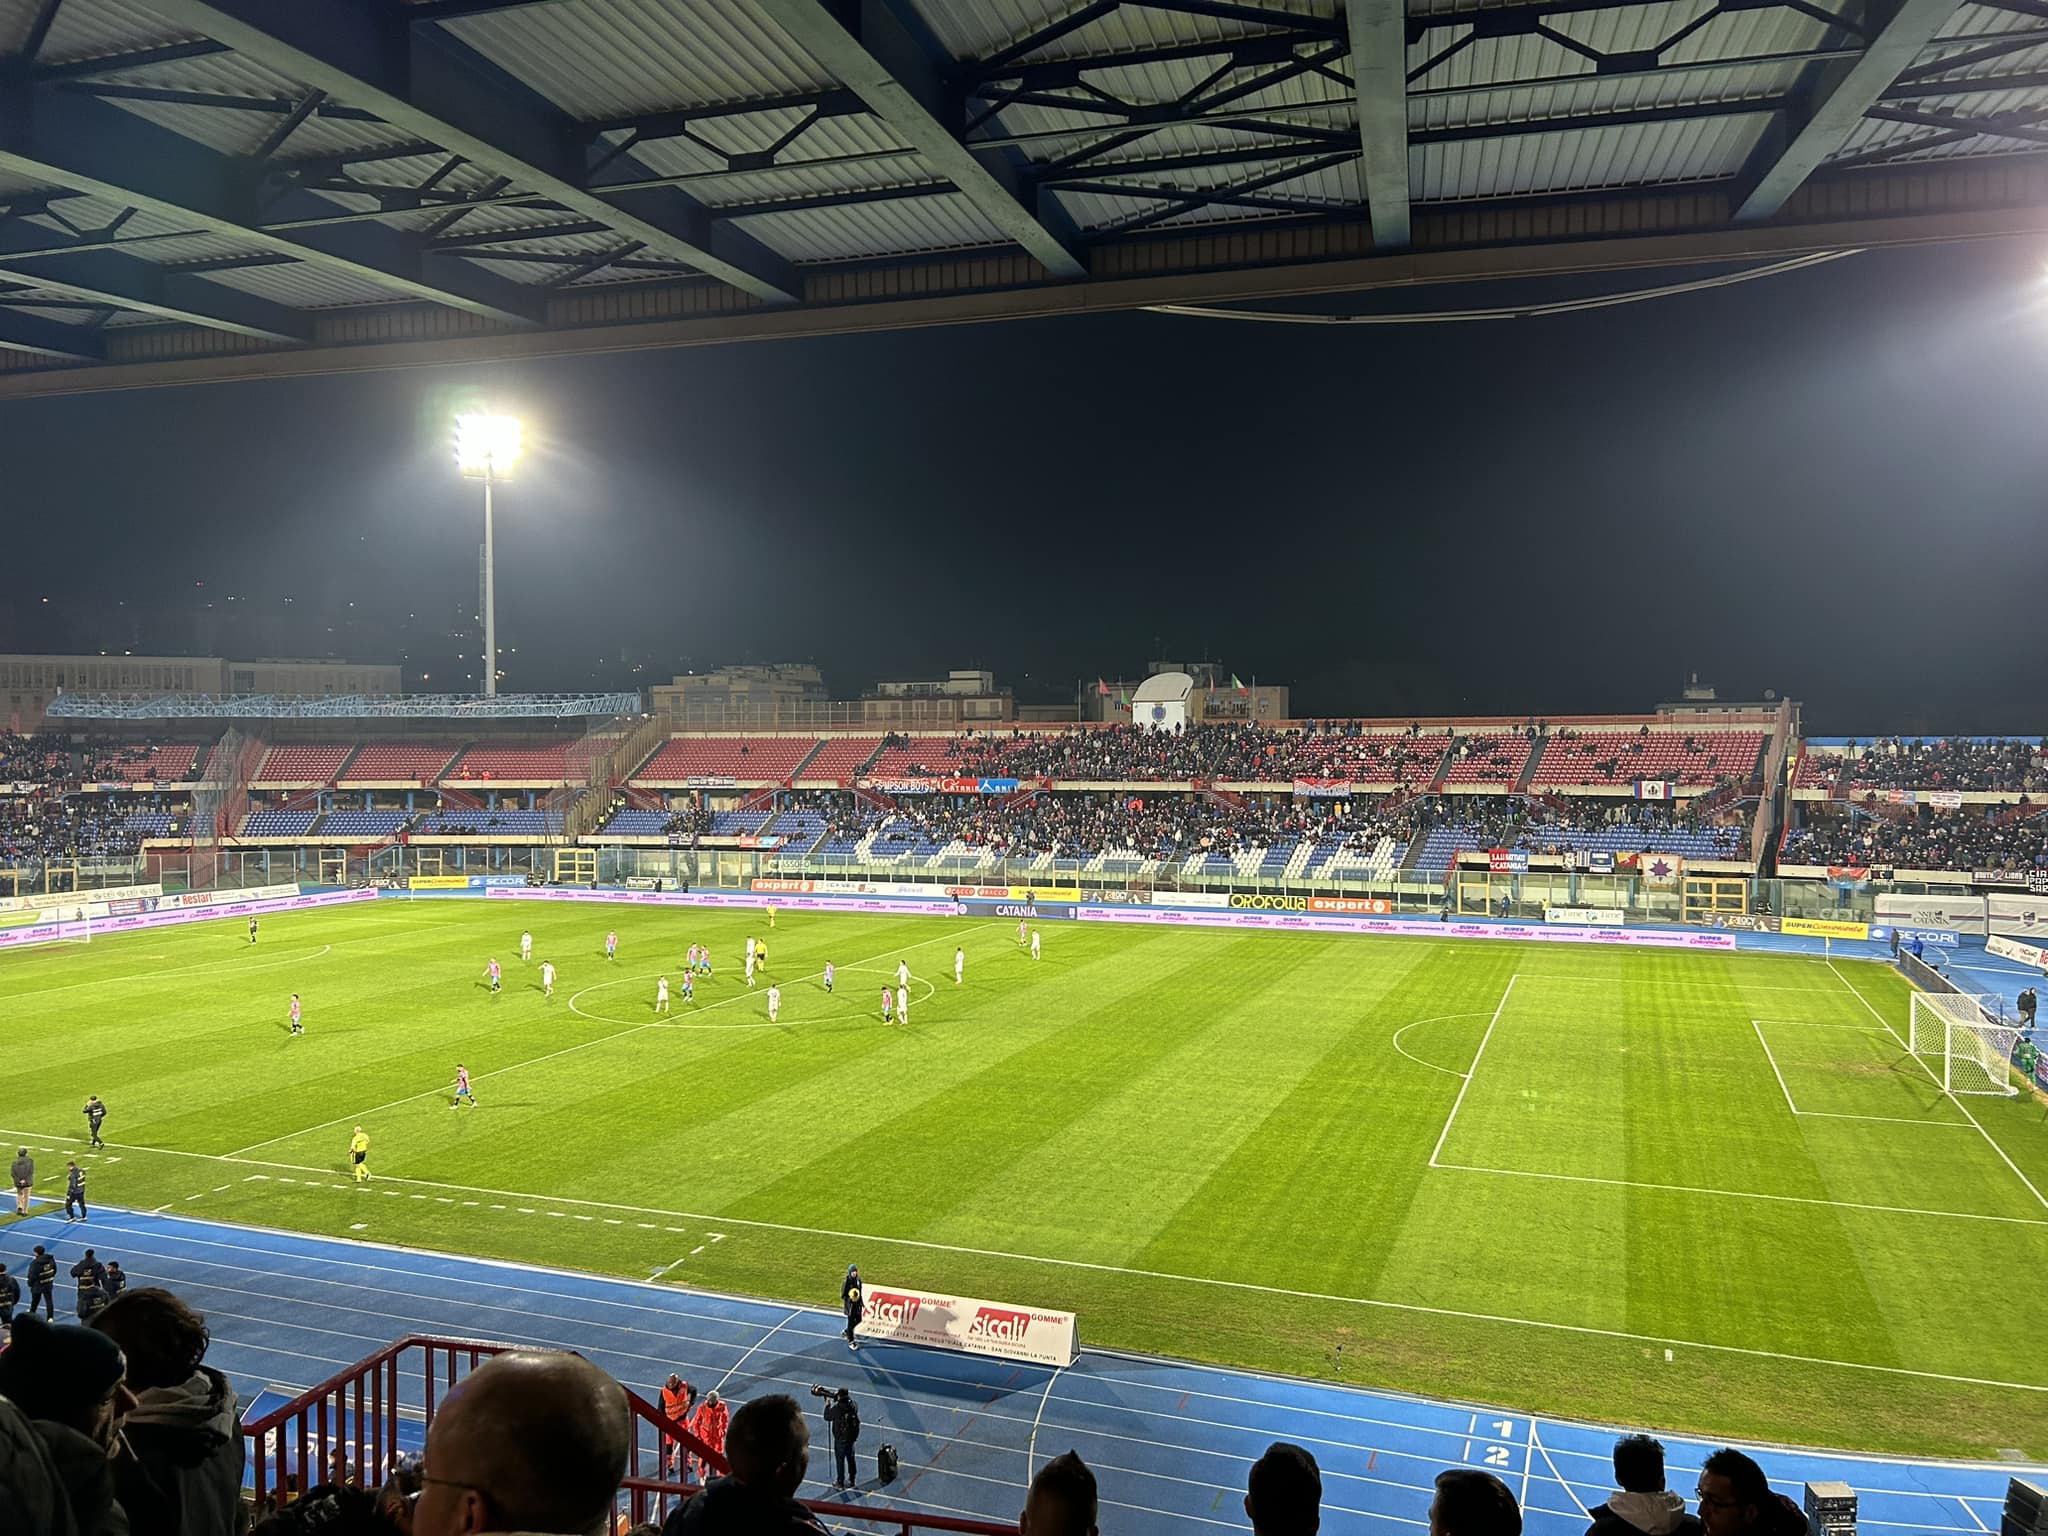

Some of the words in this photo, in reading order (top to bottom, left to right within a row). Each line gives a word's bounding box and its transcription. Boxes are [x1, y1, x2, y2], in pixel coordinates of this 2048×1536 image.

[756, 882, 800, 890] expert
[182, 892, 212, 905] Restart
[1314, 900, 1372, 911] expert
[996, 905, 1038, 917] CATANIA
[865, 1297, 917, 1323] sicali
[970, 1313, 1027, 1340] sicali
[1492, 1420, 1513, 1438] 1
[1483, 1446, 1510, 1467] 2
